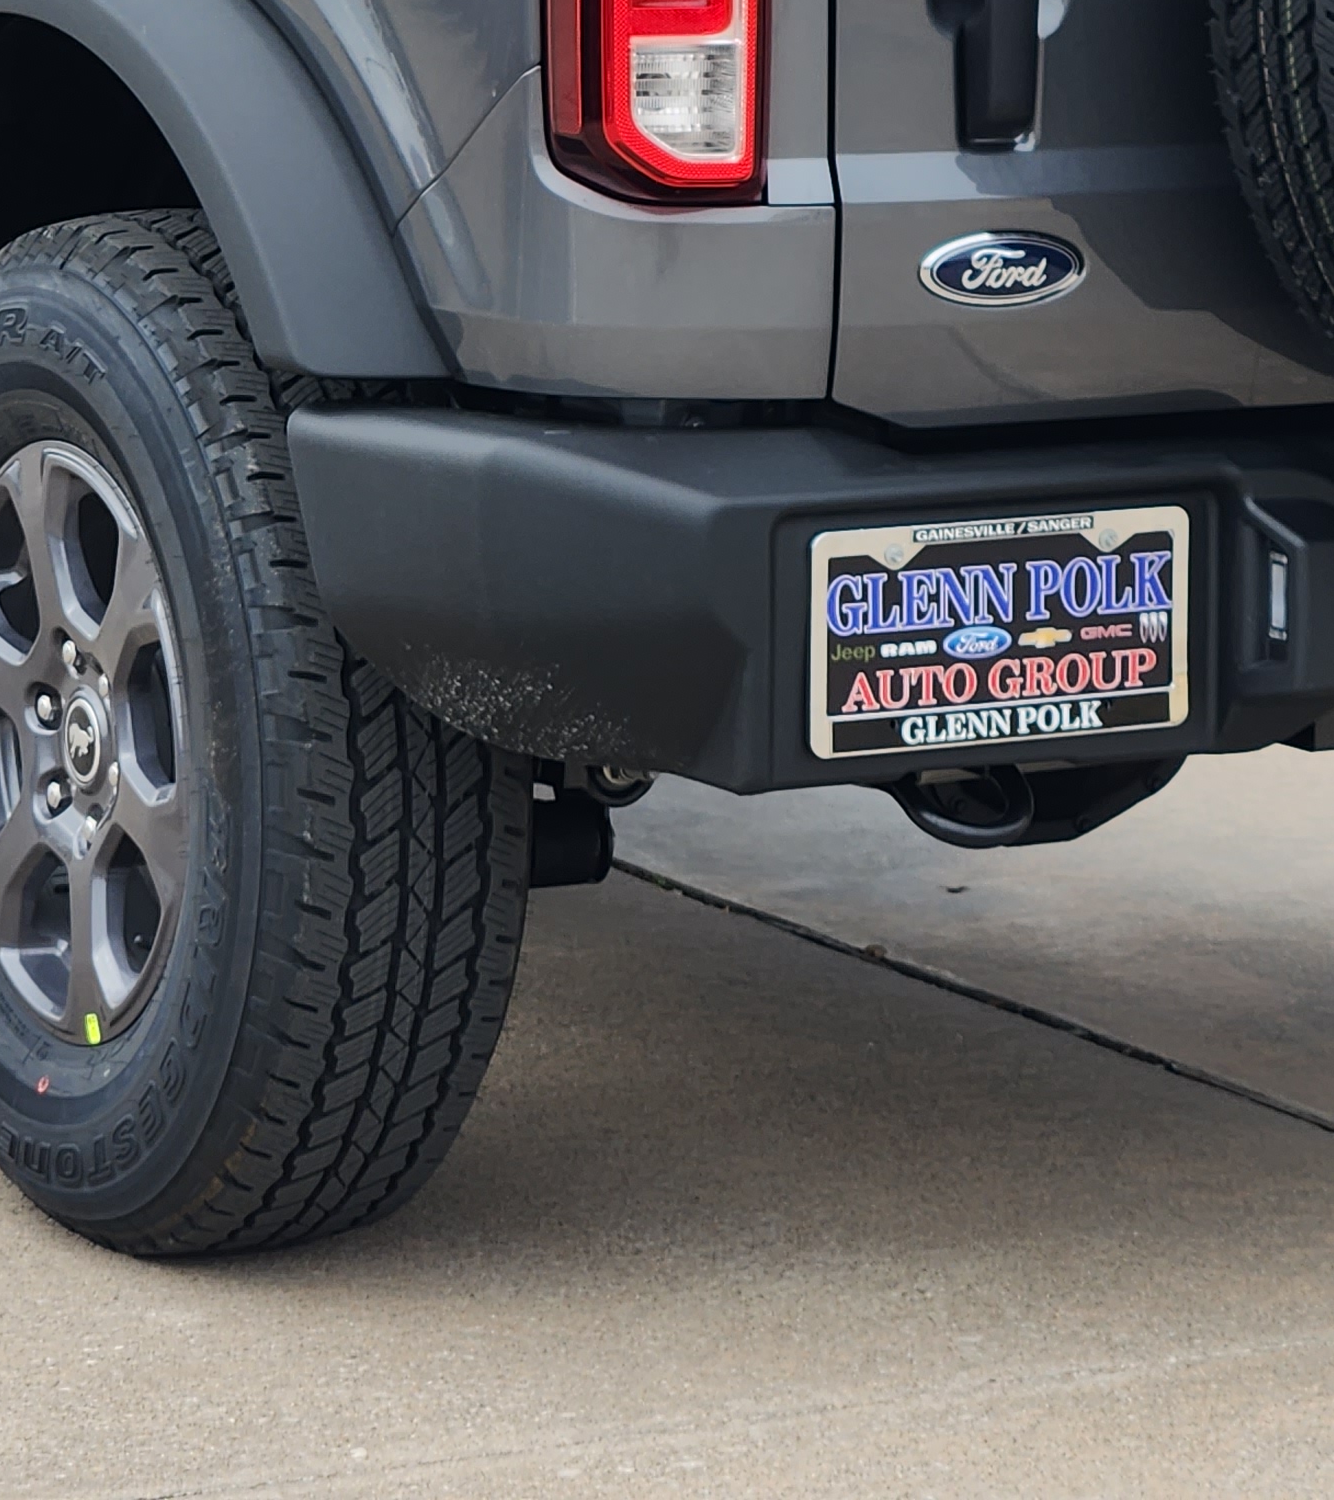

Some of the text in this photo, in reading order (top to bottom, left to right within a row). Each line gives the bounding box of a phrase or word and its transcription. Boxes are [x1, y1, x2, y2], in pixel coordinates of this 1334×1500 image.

[961, 248, 1048, 290] Ford
[826, 550, 1173, 637] GLENN POLK
[831, 623, 1133, 662] Jeep RAM Ford GMC
[841, 647, 1158, 714] AUTO GROUP
[901, 699, 1104, 746] GLENN POLK
